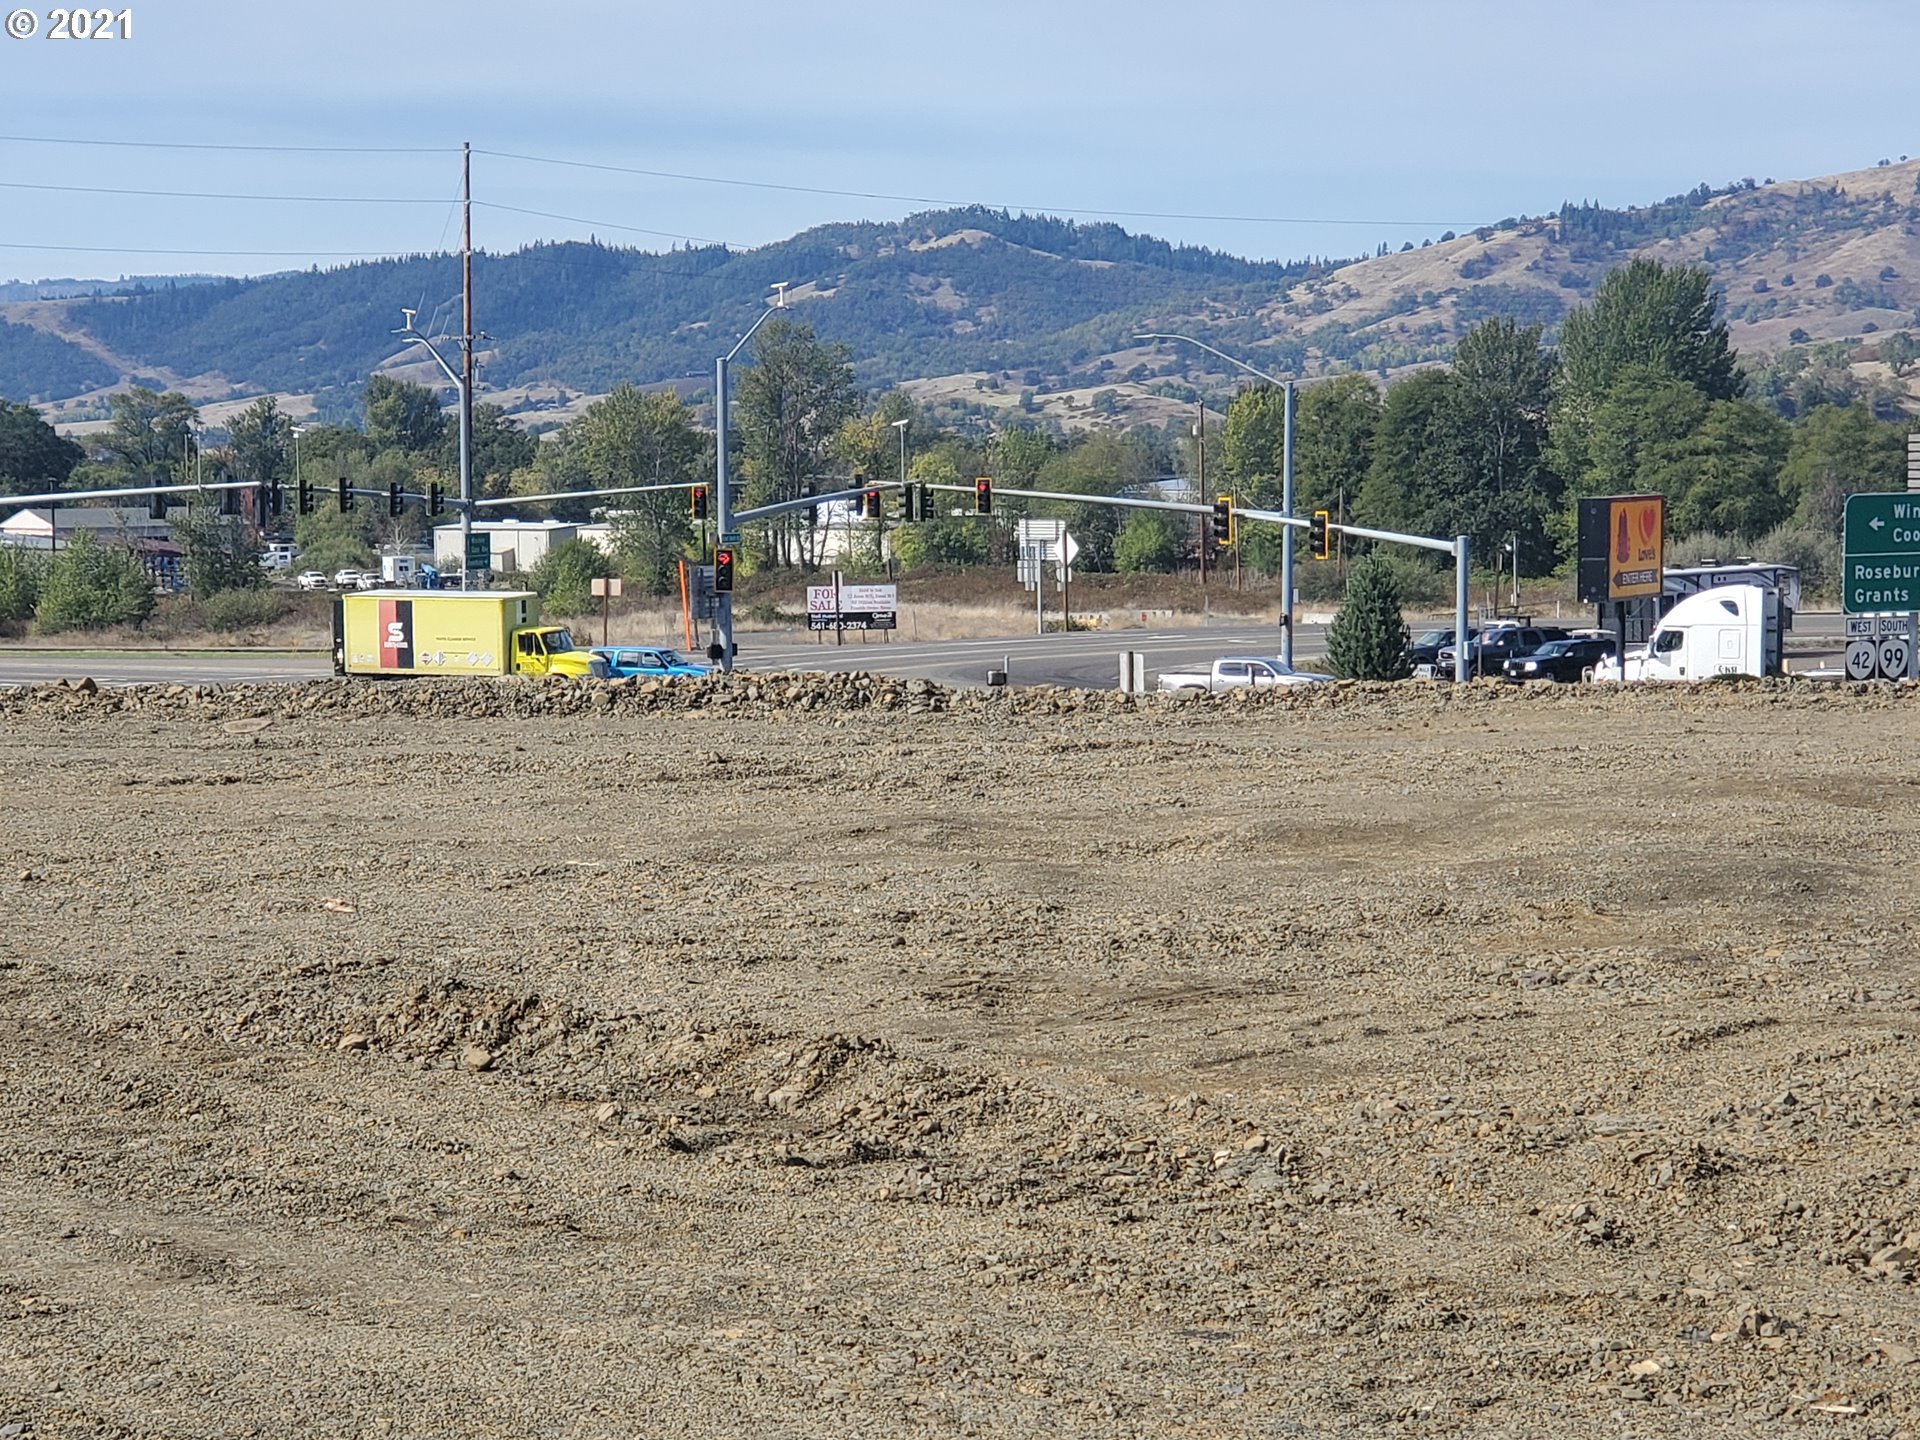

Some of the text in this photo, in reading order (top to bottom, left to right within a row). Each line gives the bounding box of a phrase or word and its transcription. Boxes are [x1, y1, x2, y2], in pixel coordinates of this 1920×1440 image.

[1893, 503, 1920, 519] Win
[1893, 527, 1920, 543] Coo
[1622, 571, 1653, 584] ENTER HERE
[1855, 564, 1920, 580] Rosebur
[1855, 587, 1909, 603] Grants
[1851, 621, 1871, 632] WEST
[1881, 620, 1908, 631] SOUTH
[1852, 651, 1870, 669] 42
[1884, 648, 1903, 668] 99
